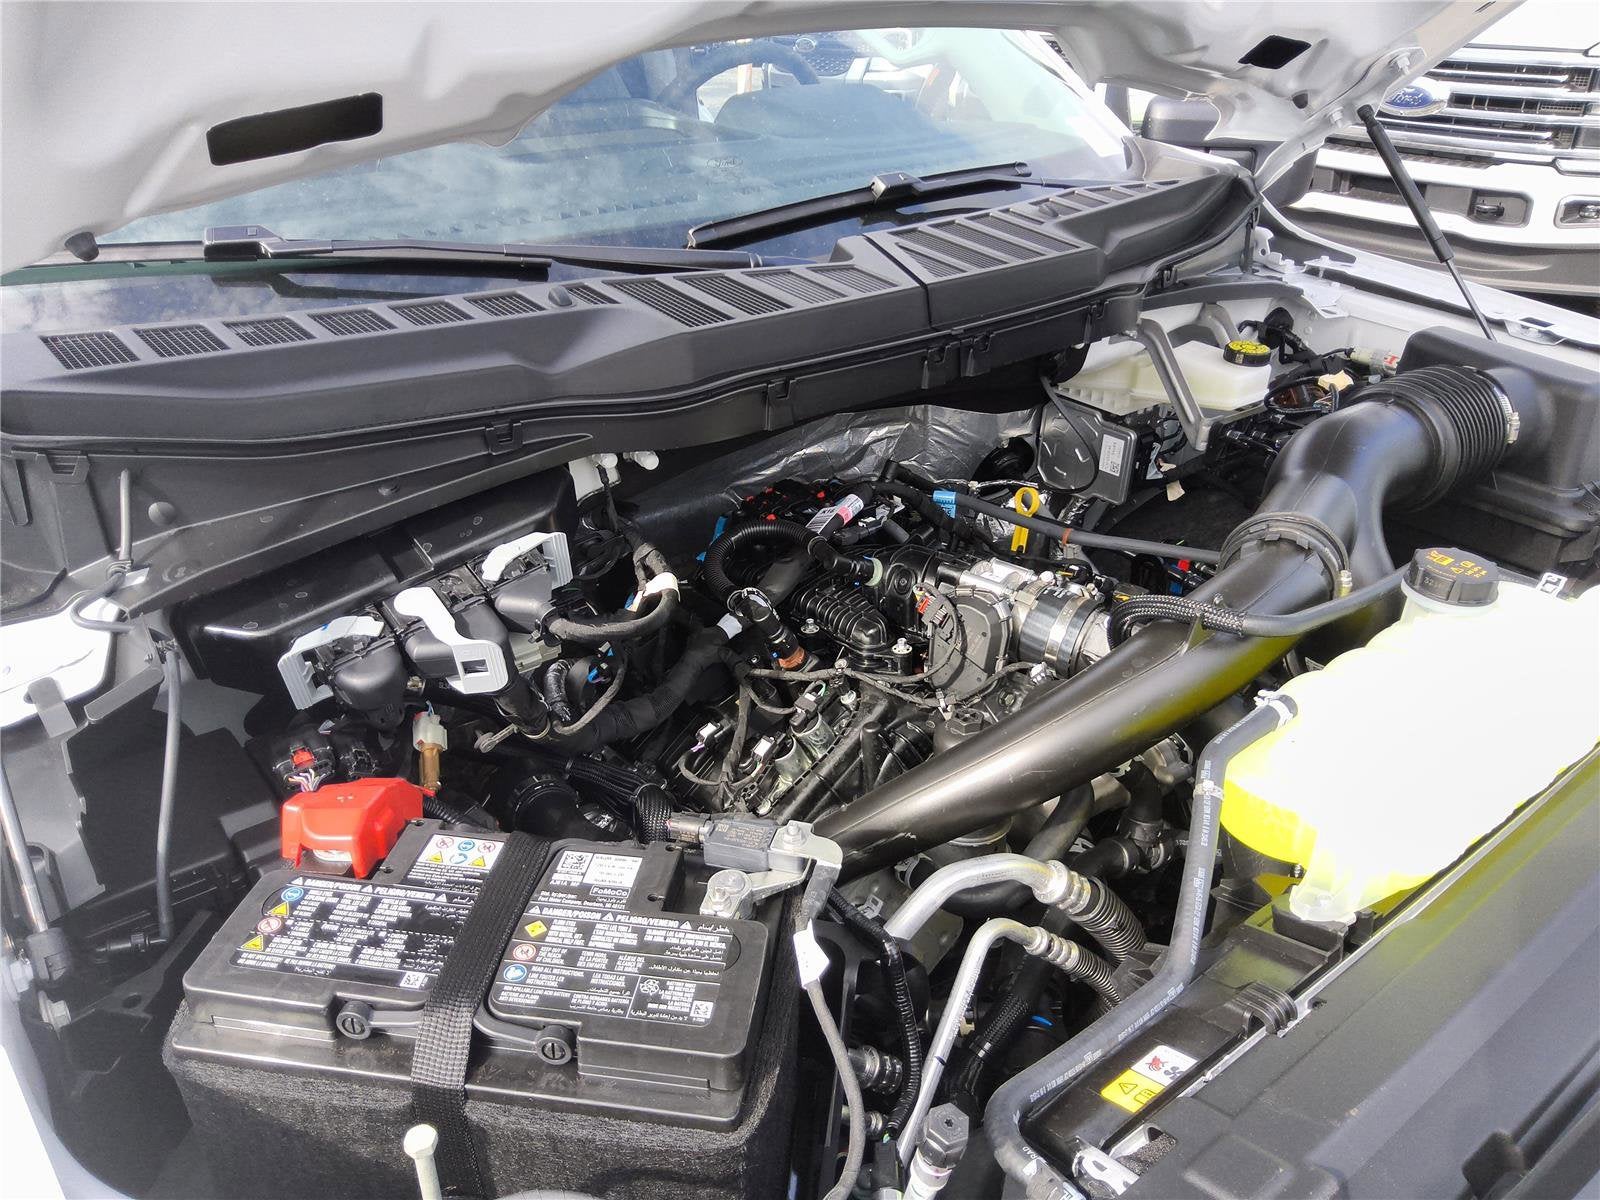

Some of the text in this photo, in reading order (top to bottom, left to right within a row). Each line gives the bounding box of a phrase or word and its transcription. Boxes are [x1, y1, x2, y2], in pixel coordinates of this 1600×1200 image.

[1391, 89, 1424, 105] Ford
[374, 887, 436, 900] PELIGRO/VENENO
[592, 887, 628, 896] FoMoCo
[542, 907, 679, 928] DANGER/POISON PELIGRO/VENENO
[1022, 1146, 1038, 1159] RAD
